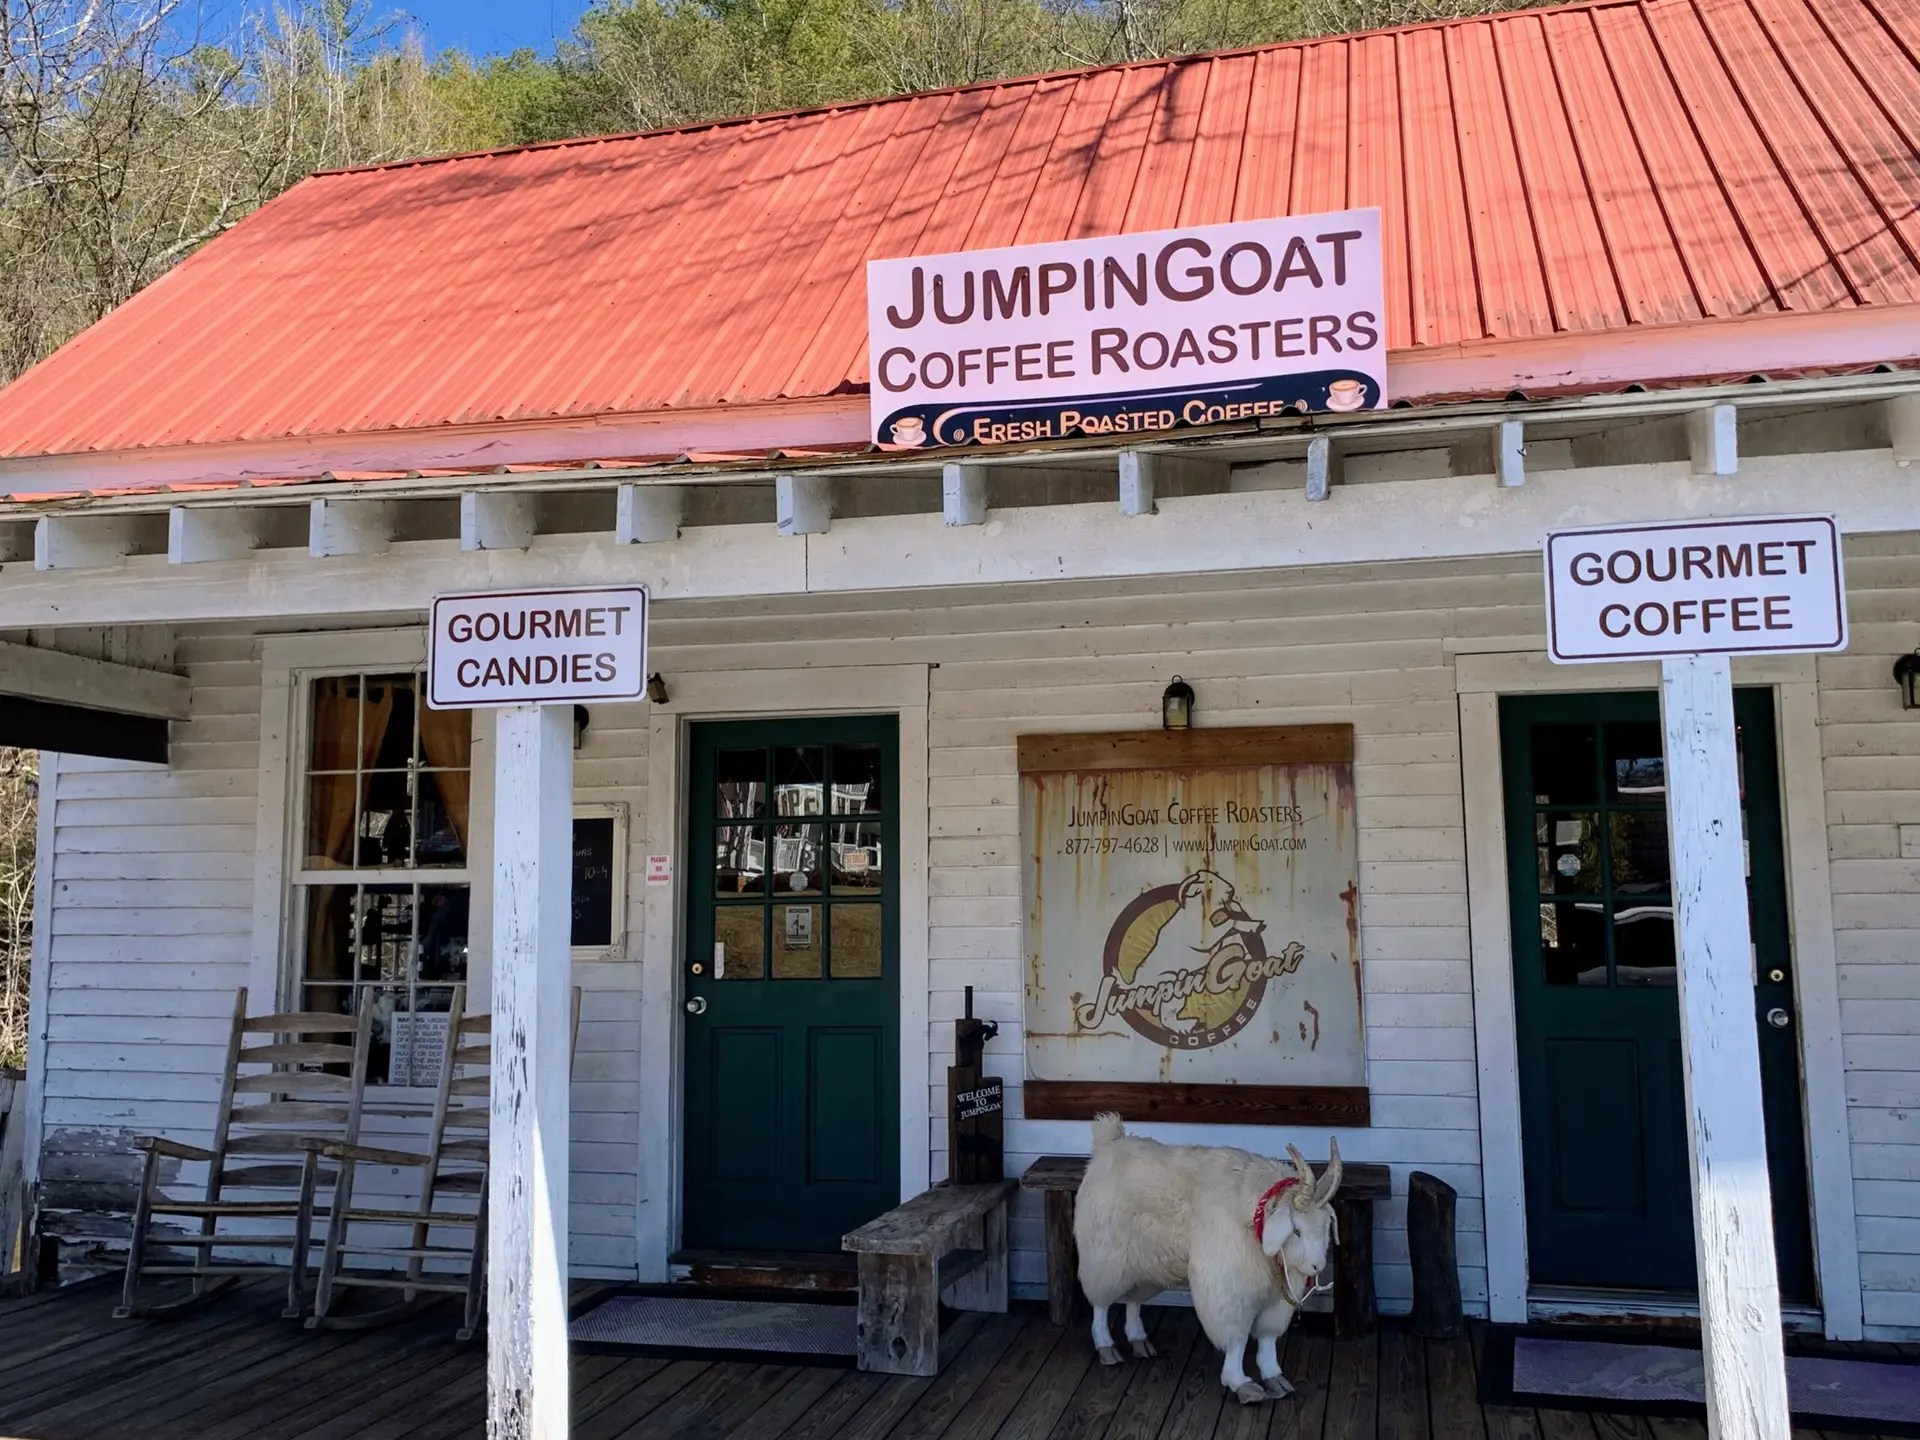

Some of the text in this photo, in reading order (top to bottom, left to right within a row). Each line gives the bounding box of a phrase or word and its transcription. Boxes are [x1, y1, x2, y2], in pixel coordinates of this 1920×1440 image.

[886, 229, 1363, 330] JUMPINGOAT
[878, 310, 1379, 393] COFFEE ROASTERS
[973, 417, 1050, 444] FRESH
[1060, 409, 1175, 434] ROASTED
[1569, 539, 1817, 587] GOURMET
[448, 606, 631, 643] GOURMET
[1598, 595, 1793, 638] COFFEE
[457, 652, 617, 688] CANDIES
[1167, 801, 1220, 826] COFFEE
[1226, 800, 1303, 824] ROASTERS
[1065, 837, 1160, 855] 877-797-4628
[1168, 998, 1257, 1047] COFFEE
[957, 1085, 1001, 1102] WELCOME
[961, 1102, 1002, 1120] JUMPINGOA
[974, 1098, 987, 1107] TO
